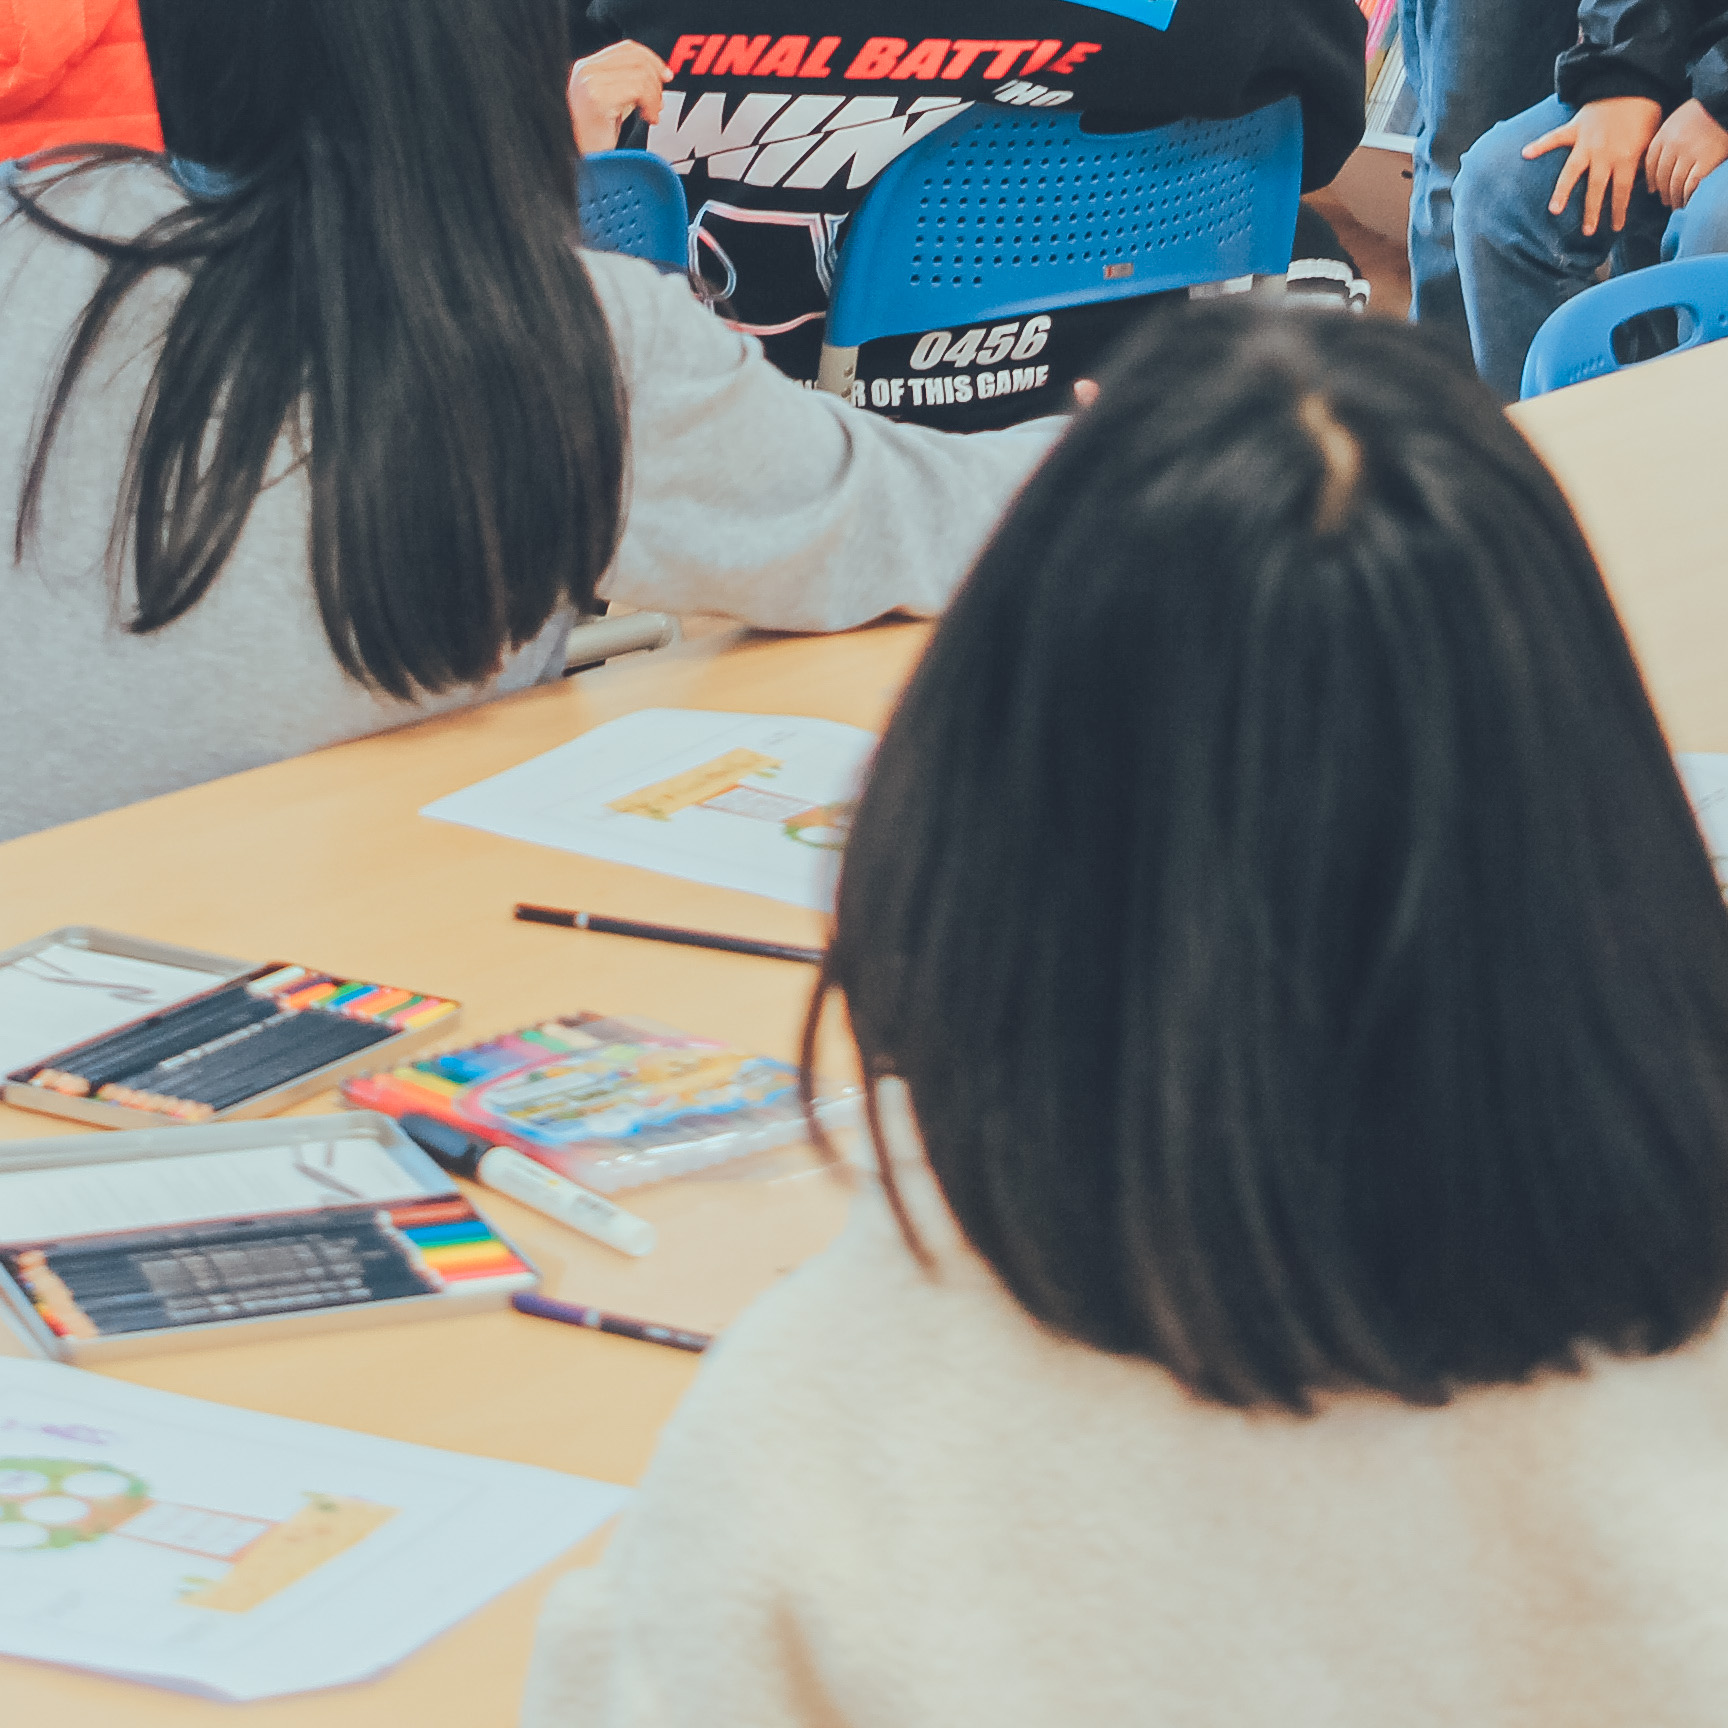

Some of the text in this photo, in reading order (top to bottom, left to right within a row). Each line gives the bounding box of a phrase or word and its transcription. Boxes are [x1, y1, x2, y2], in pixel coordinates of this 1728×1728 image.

[669, 34, 1102, 80] FINAL BATTLE
[910, 315, 1052, 370] 0456
[872, 378, 905, 408] OF
[908, 374, 974, 406] THIS
[976, 365, 1050, 399] GAME
